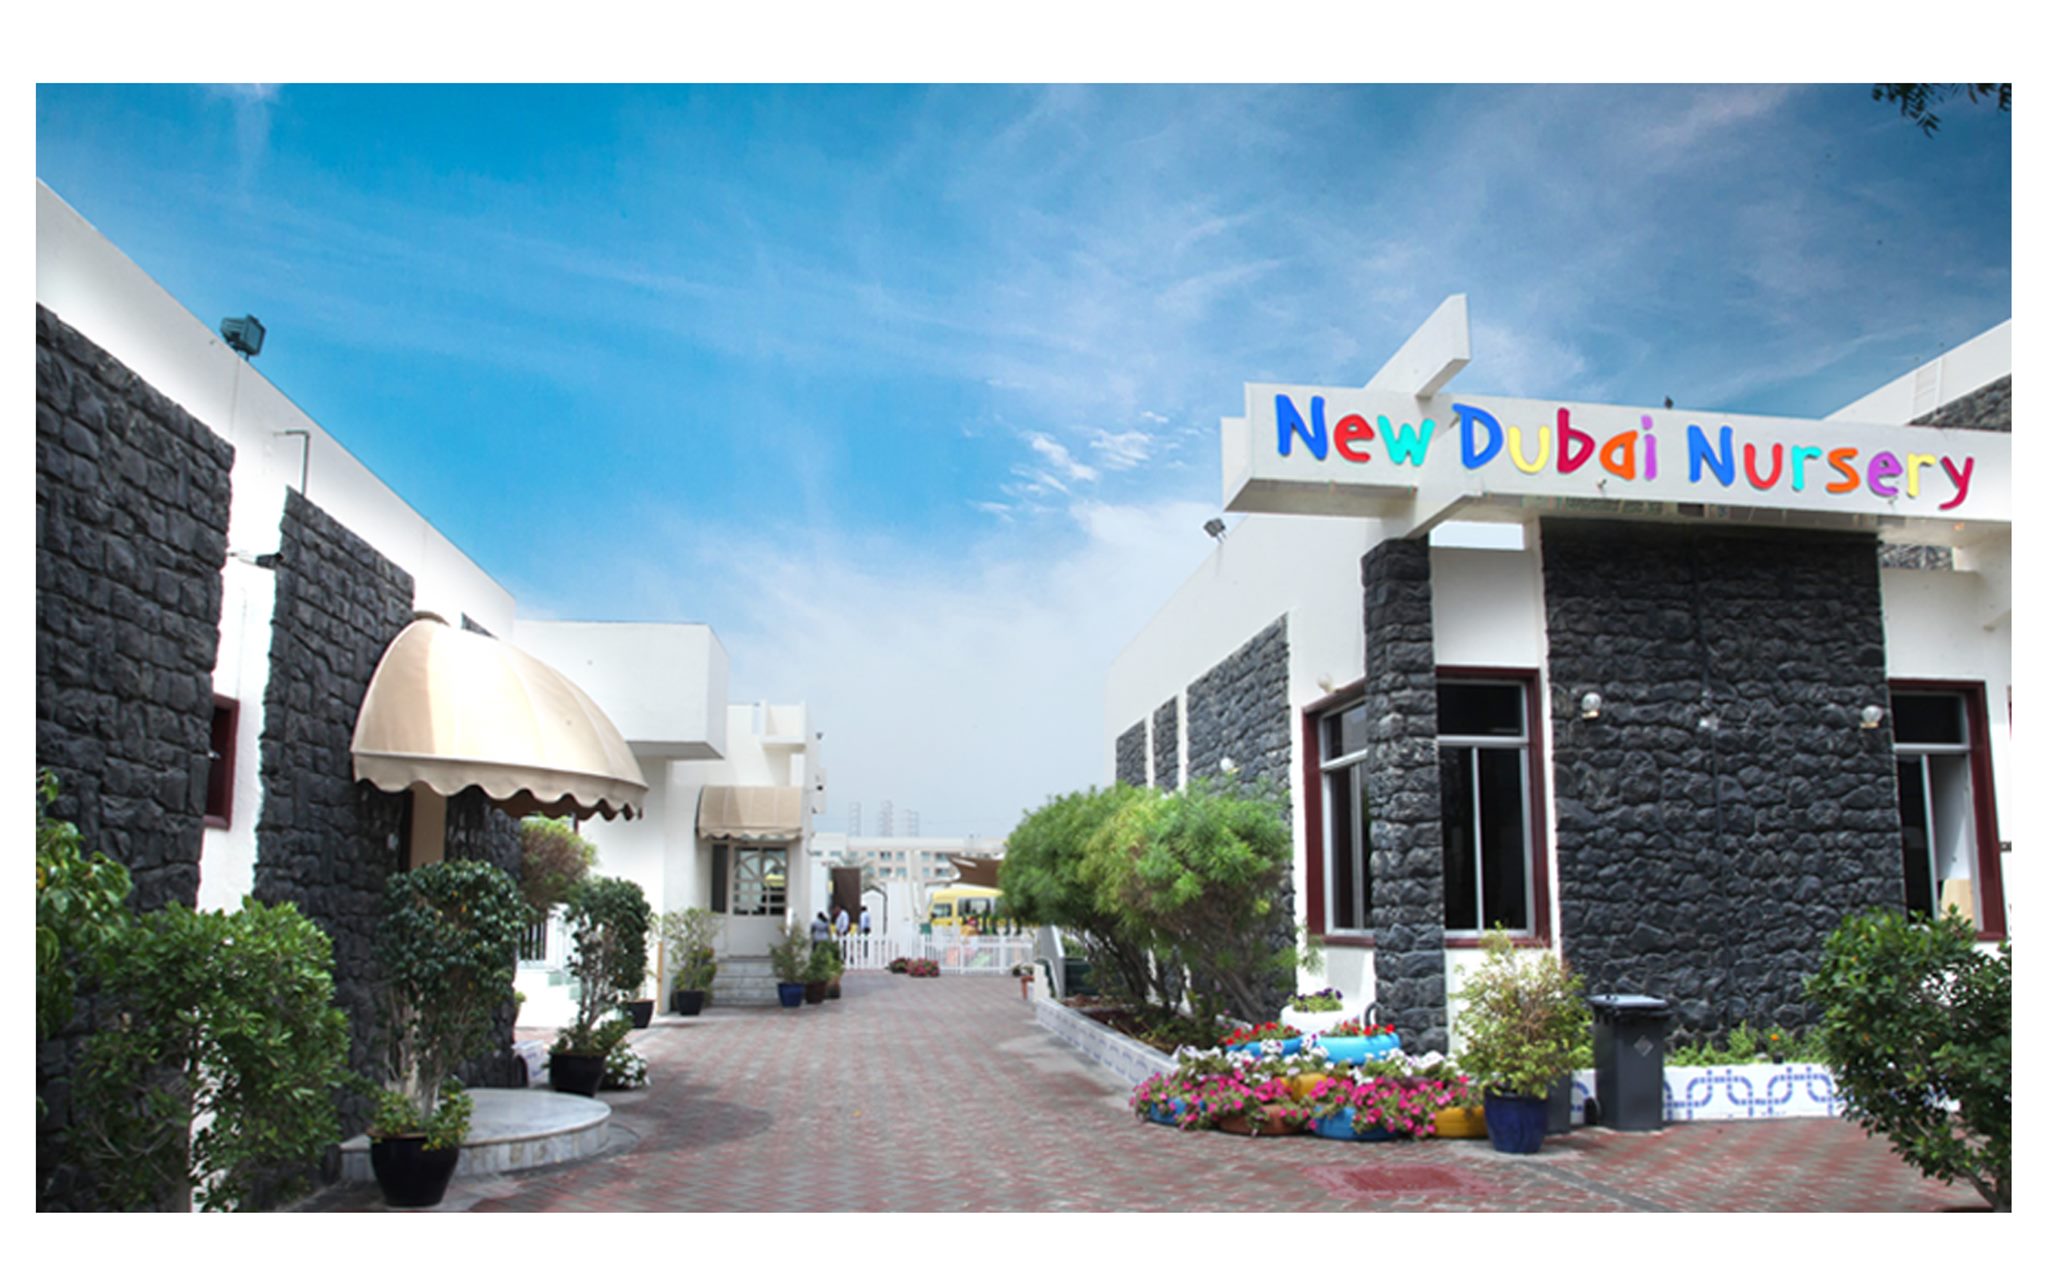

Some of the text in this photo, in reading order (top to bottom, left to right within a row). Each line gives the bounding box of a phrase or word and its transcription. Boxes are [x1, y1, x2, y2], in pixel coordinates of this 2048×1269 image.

[1274, 393, 1976, 511] New Dubai Nursery
